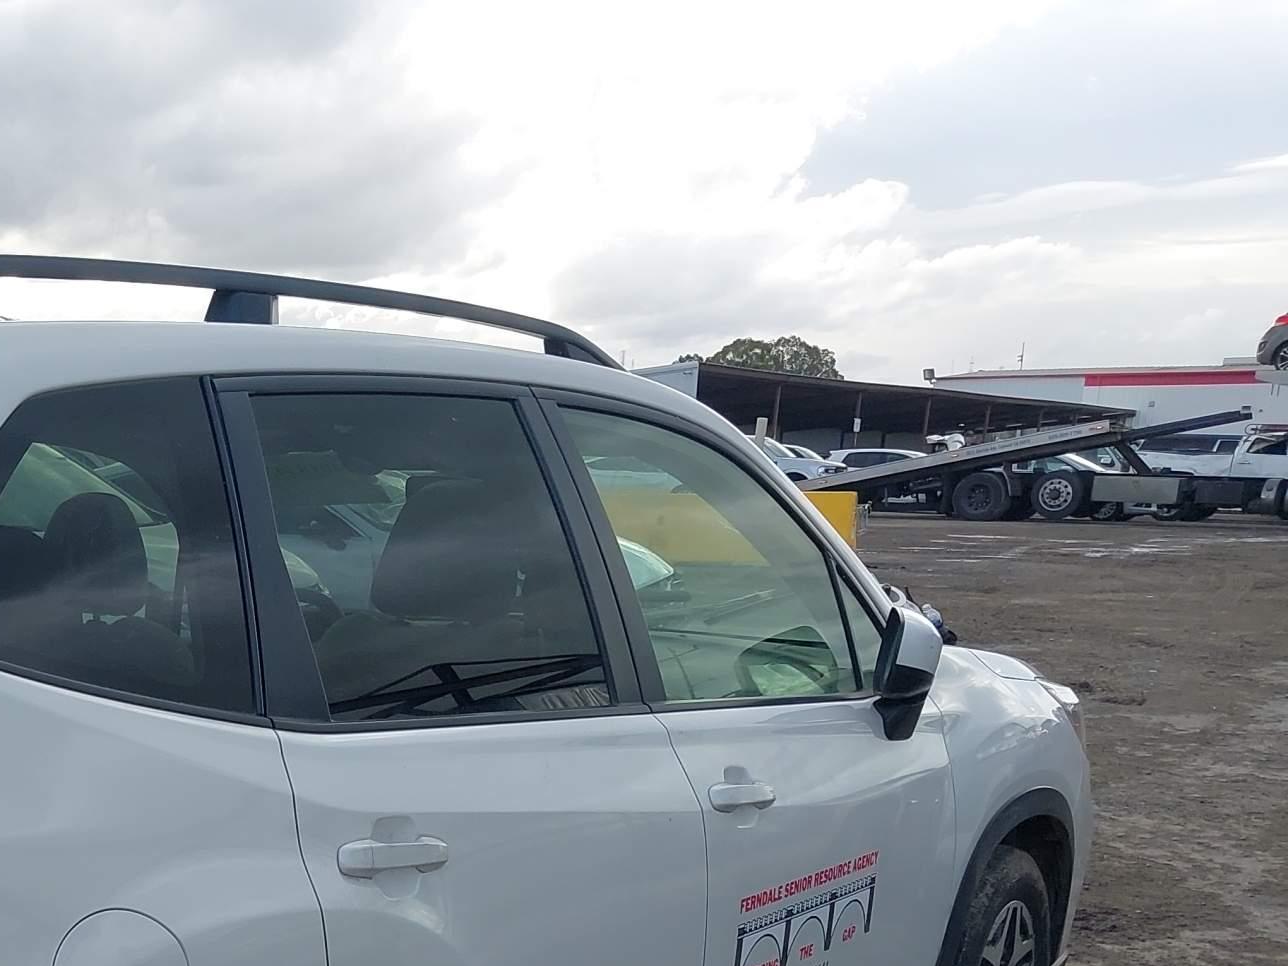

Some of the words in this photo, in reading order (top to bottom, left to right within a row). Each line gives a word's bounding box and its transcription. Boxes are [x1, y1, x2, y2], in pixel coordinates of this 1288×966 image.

[739, 884, 783, 915] FERNDALE
[785, 875, 812, 899] SENIOR
[813, 860, 851, 886] RESOURCE
[852, 849, 880, 872] AGENCY
[799, 944, 814, 961] THE
[842, 925, 856, 942] GAP
